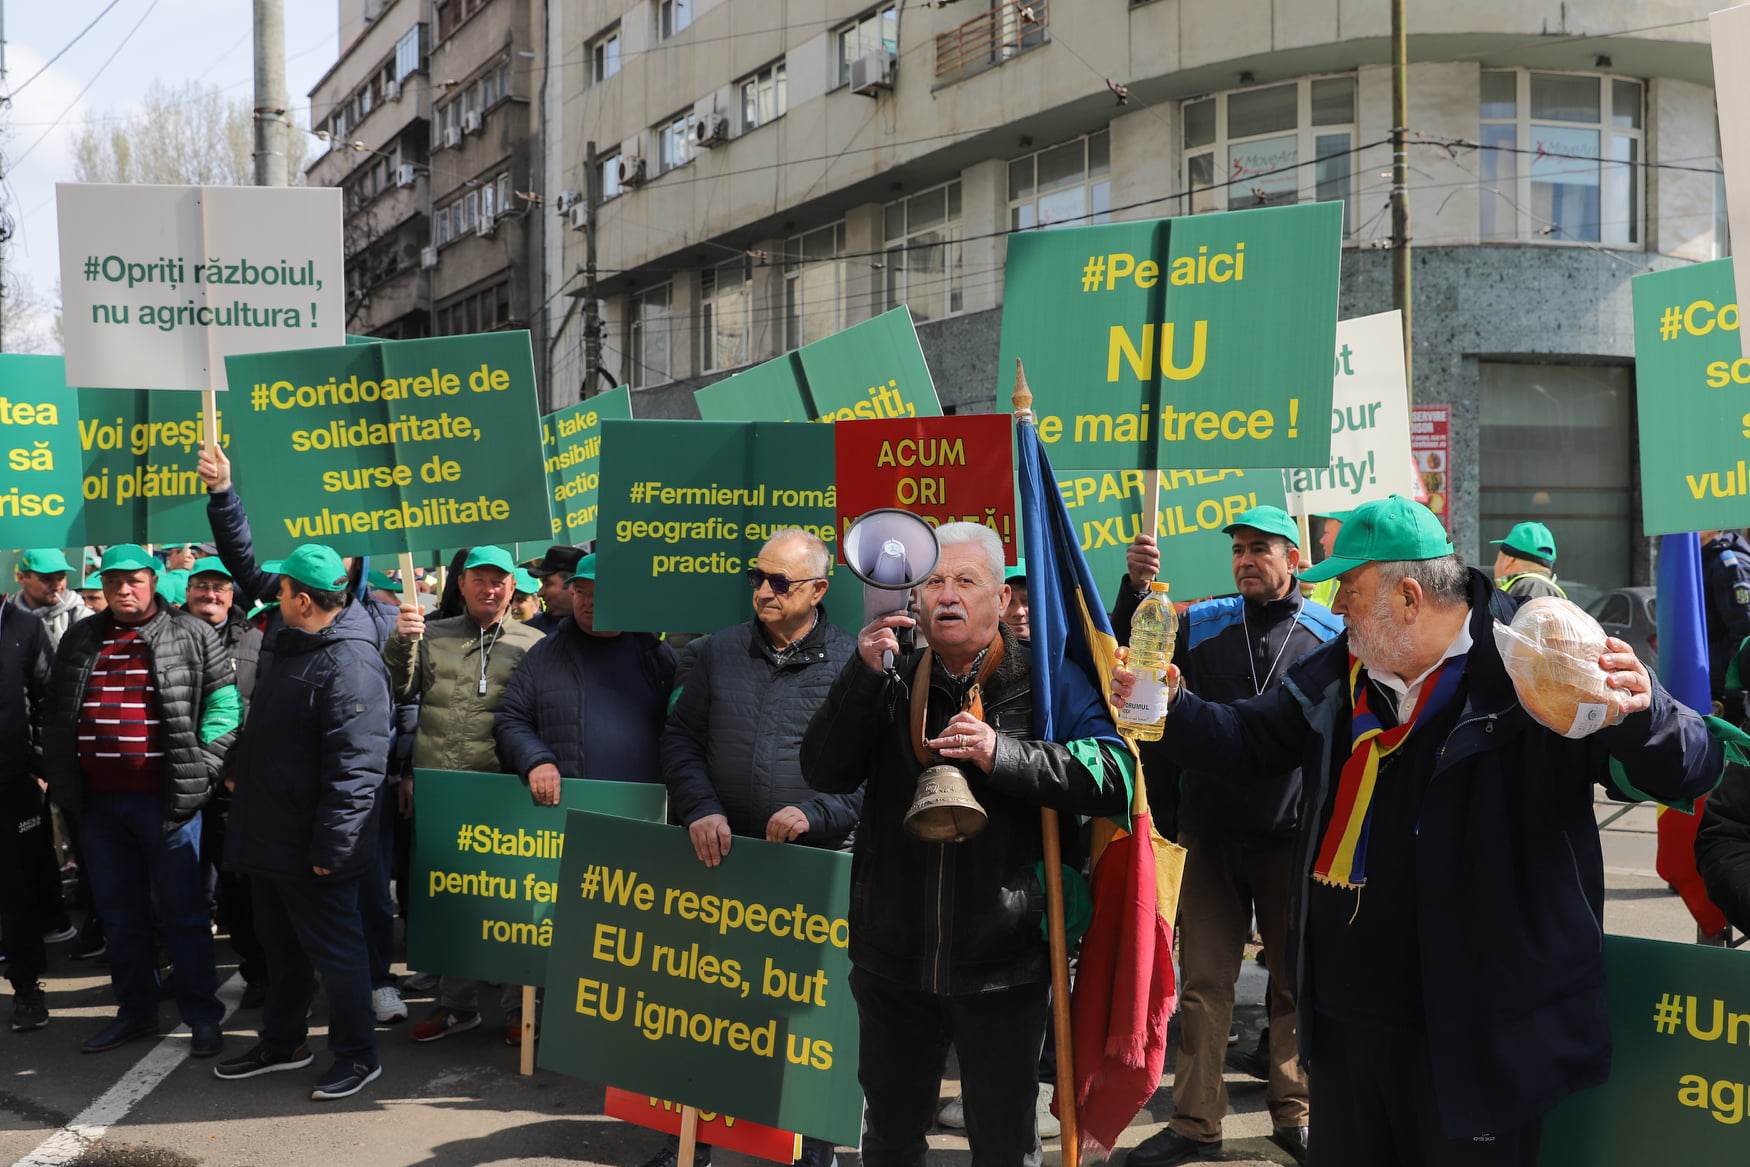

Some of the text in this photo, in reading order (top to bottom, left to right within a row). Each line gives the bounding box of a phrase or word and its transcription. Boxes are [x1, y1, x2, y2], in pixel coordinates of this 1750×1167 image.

[84, 255, 321, 290] #Opriți războiul,
[1082, 242, 1244, 292] #Pe aici
[92, 301, 316, 331] nu agricultura !
[1106, 319, 1208, 382] NU
[1335, 344, 1354, 377] t
[251, 363, 509, 411] #Coridoarele de
[1706, 356, 1750, 387] so
[79, 411, 231, 456] Voi greșii,
[291, 412, 480, 451] solidaritate,
[559, 411, 600, 440] take
[1034, 398, 1299, 445] e mai trece !
[9, 441, 53, 470] să
[877, 437, 967, 467] ACUM
[322, 454, 461, 491] surse de
[555, 472, 600, 502] actio
[1686, 460, 1750, 500] vul
[0, 487, 64, 515] risc
[630, 481, 764, 505] #Fermierul
[896, 476, 947, 505] ORI
[285, 495, 509, 537] vulnerabilitate
[616, 517, 736, 543] geografic
[652, 553, 740, 576] practic
[429, 870, 516, 899] pentru
[581, 863, 654, 910] #We
[592, 923, 828, 1007] EU rules, but
[575, 977, 832, 1070] EU ignored us
